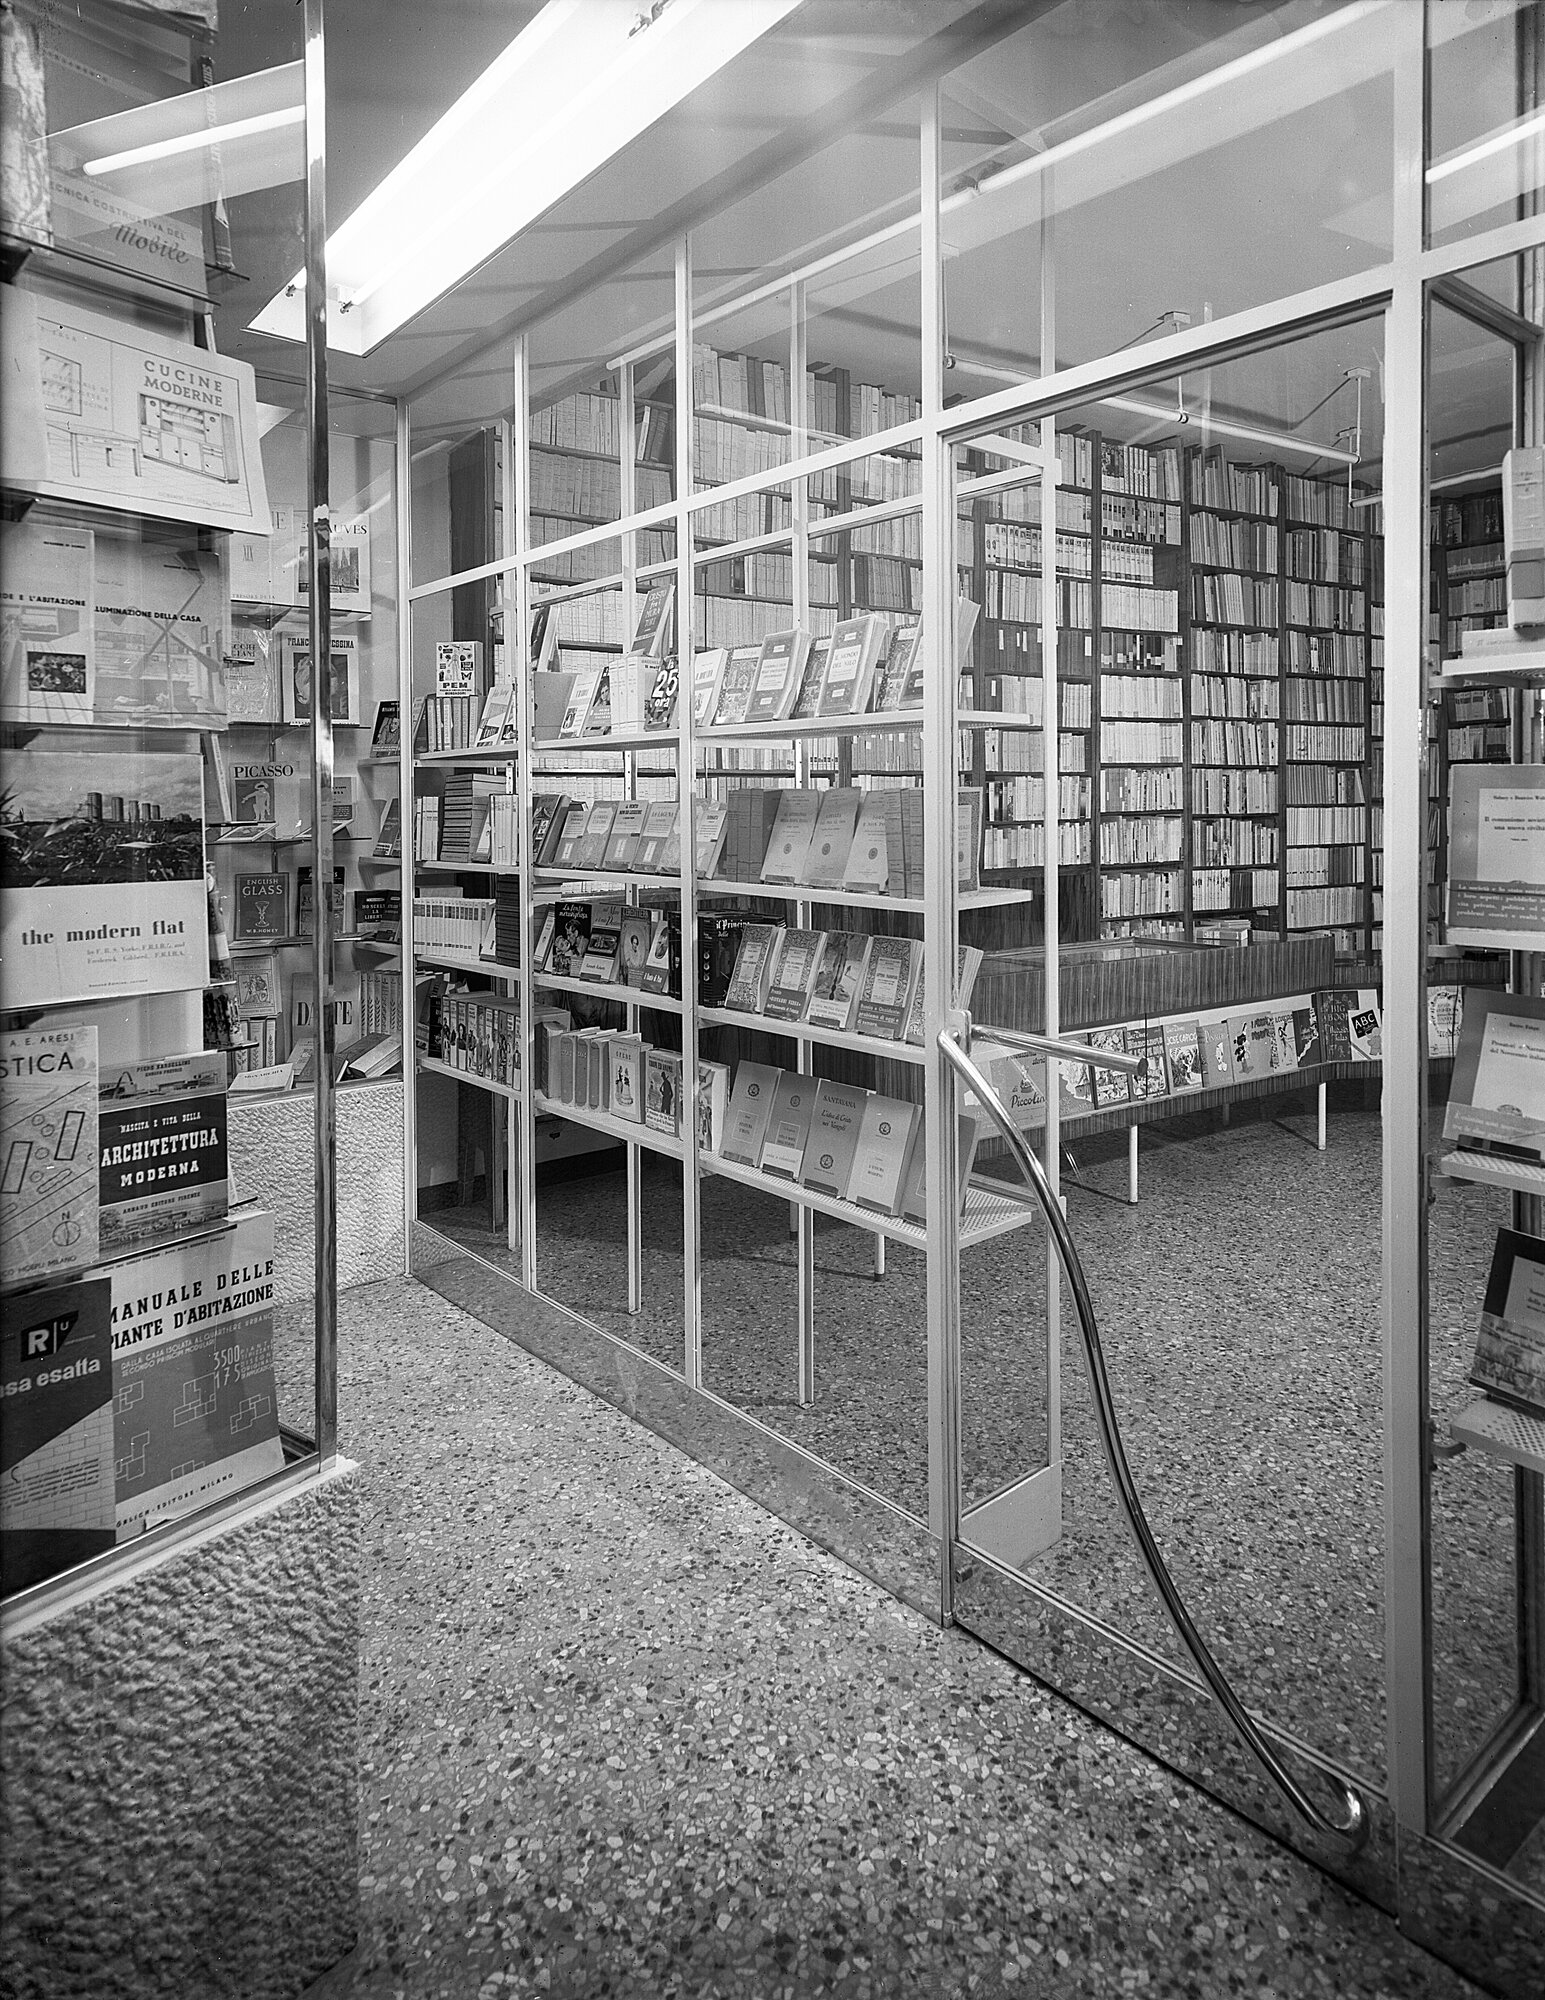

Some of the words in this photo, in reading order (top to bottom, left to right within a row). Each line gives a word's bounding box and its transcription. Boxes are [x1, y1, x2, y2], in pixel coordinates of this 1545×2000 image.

[109, 221, 189, 264] Mobile
[144, 360, 222, 392] CUCINE
[144, 376, 222, 407] MODERNE
[29, 594, 86, 606] L'ABITAZIONE
[94, 606, 152, 618] LUMINAZIONE
[154, 612, 178, 621] DELLA
[180, 614, 201, 623] CASA
[331, 640, 354, 648] ESSINA
[654, 697, 670, 708] ora
[234, 765, 294, 778] PICASSO
[242, 885, 283, 896] GLASS
[21, 929, 54, 945] the
[66, 924, 141, 942] modern
[152, 920, 185, 936] flat
[297, 1001, 353, 1027] DTE
[1355, 1013, 1375, 1030] ABC
[9, 1037, 18, 1047] A.
[25, 1037, 34, 1046] E.
[40, 1033, 74, 1044] ARESI
[120, 1121, 150, 1134] NASCITA
[153, 1119, 159, 1128] E
[162, 1115, 179, 1127] VITA
[182, 1111, 202, 1123] DELLA
[101, 1127, 219, 1168] ARCHITETTURA
[120, 1159, 200, 1187] MODERNA
[61, 1211, 71, 1221] N
[111, 1281, 202, 1324] MANUALE
[217, 1260, 274, 1290] DELLE
[174, 1283, 273, 1330] D'ABITAZIONE
[28, 1328, 49, 1355] R
[60, 1320, 70, 1332] U
[146, 1351, 164, 1361] CASA
[166, 1341, 192, 1354] ISOLATA
[195, 1336, 203, 1344] AL
[245, 1312, 274, 1327] URBANO
[213, 1344, 240, 1371] 3500
[36, 1357, 101, 1387] esatta
[214, 1362, 240, 1389] 175
[157, 1490, 194, 1510] EDITORE
[200, 1472, 234, 1491] MILANO
